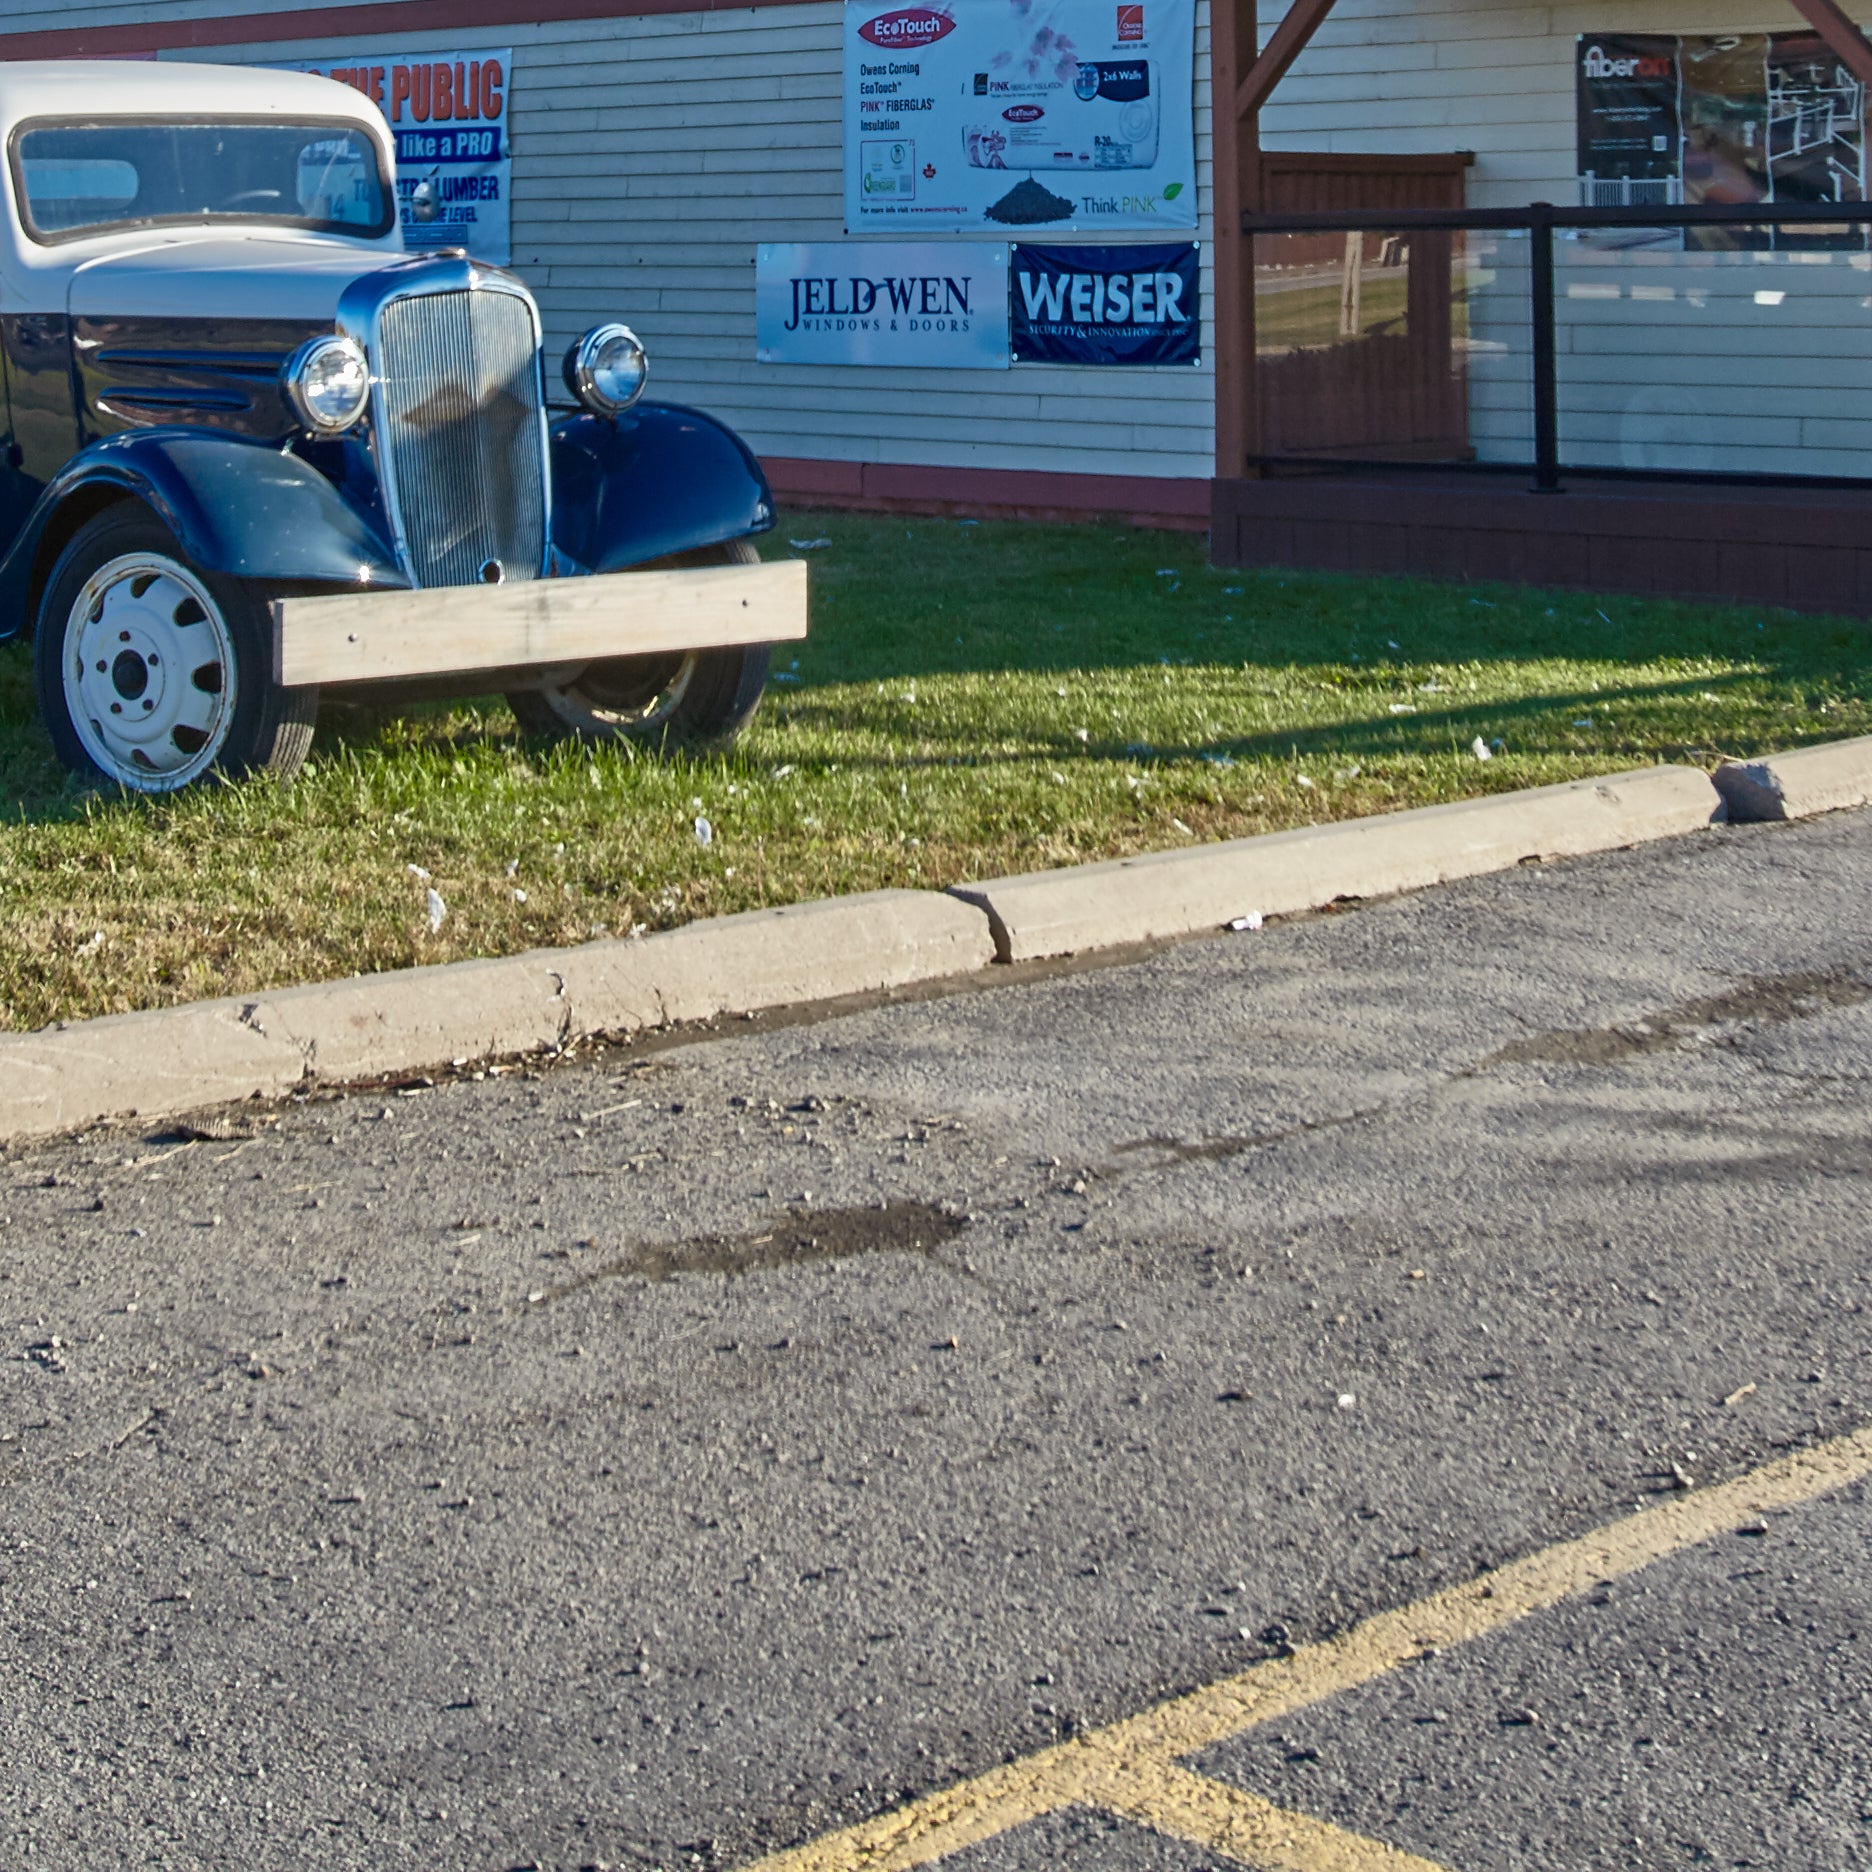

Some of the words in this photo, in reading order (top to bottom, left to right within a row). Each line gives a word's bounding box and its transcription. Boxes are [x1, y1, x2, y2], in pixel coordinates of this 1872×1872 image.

[874, 17, 940, 36] EcoTouch
[860, 63, 887, 76] Owens
[888, 61, 920, 77] Corning
[1583, 45, 1669, 77] fiberon
[391, 59, 503, 123] PUBLIC
[990, 81, 1009, 92] PINK
[860, 120, 900, 132] Insulation
[402, 132, 436, 157] like
[440, 139, 452, 156] a
[456, 131, 493, 156] PRO
[1082, 197, 1119, 214] Think
[1122, 196, 1157, 213] PINK
[448, 207, 477, 223] LEVEL
[1019, 272, 1187, 323] WEISER
[803, 319, 880, 331] WINDOWS
[890, 319, 898, 331] &
[910, 319, 970, 332] DOORS
[1029, 324, 1076, 336] SECURITY
[1076, 324, 1088, 339] &
[1088, 326, 1150, 338] INNOVATION
